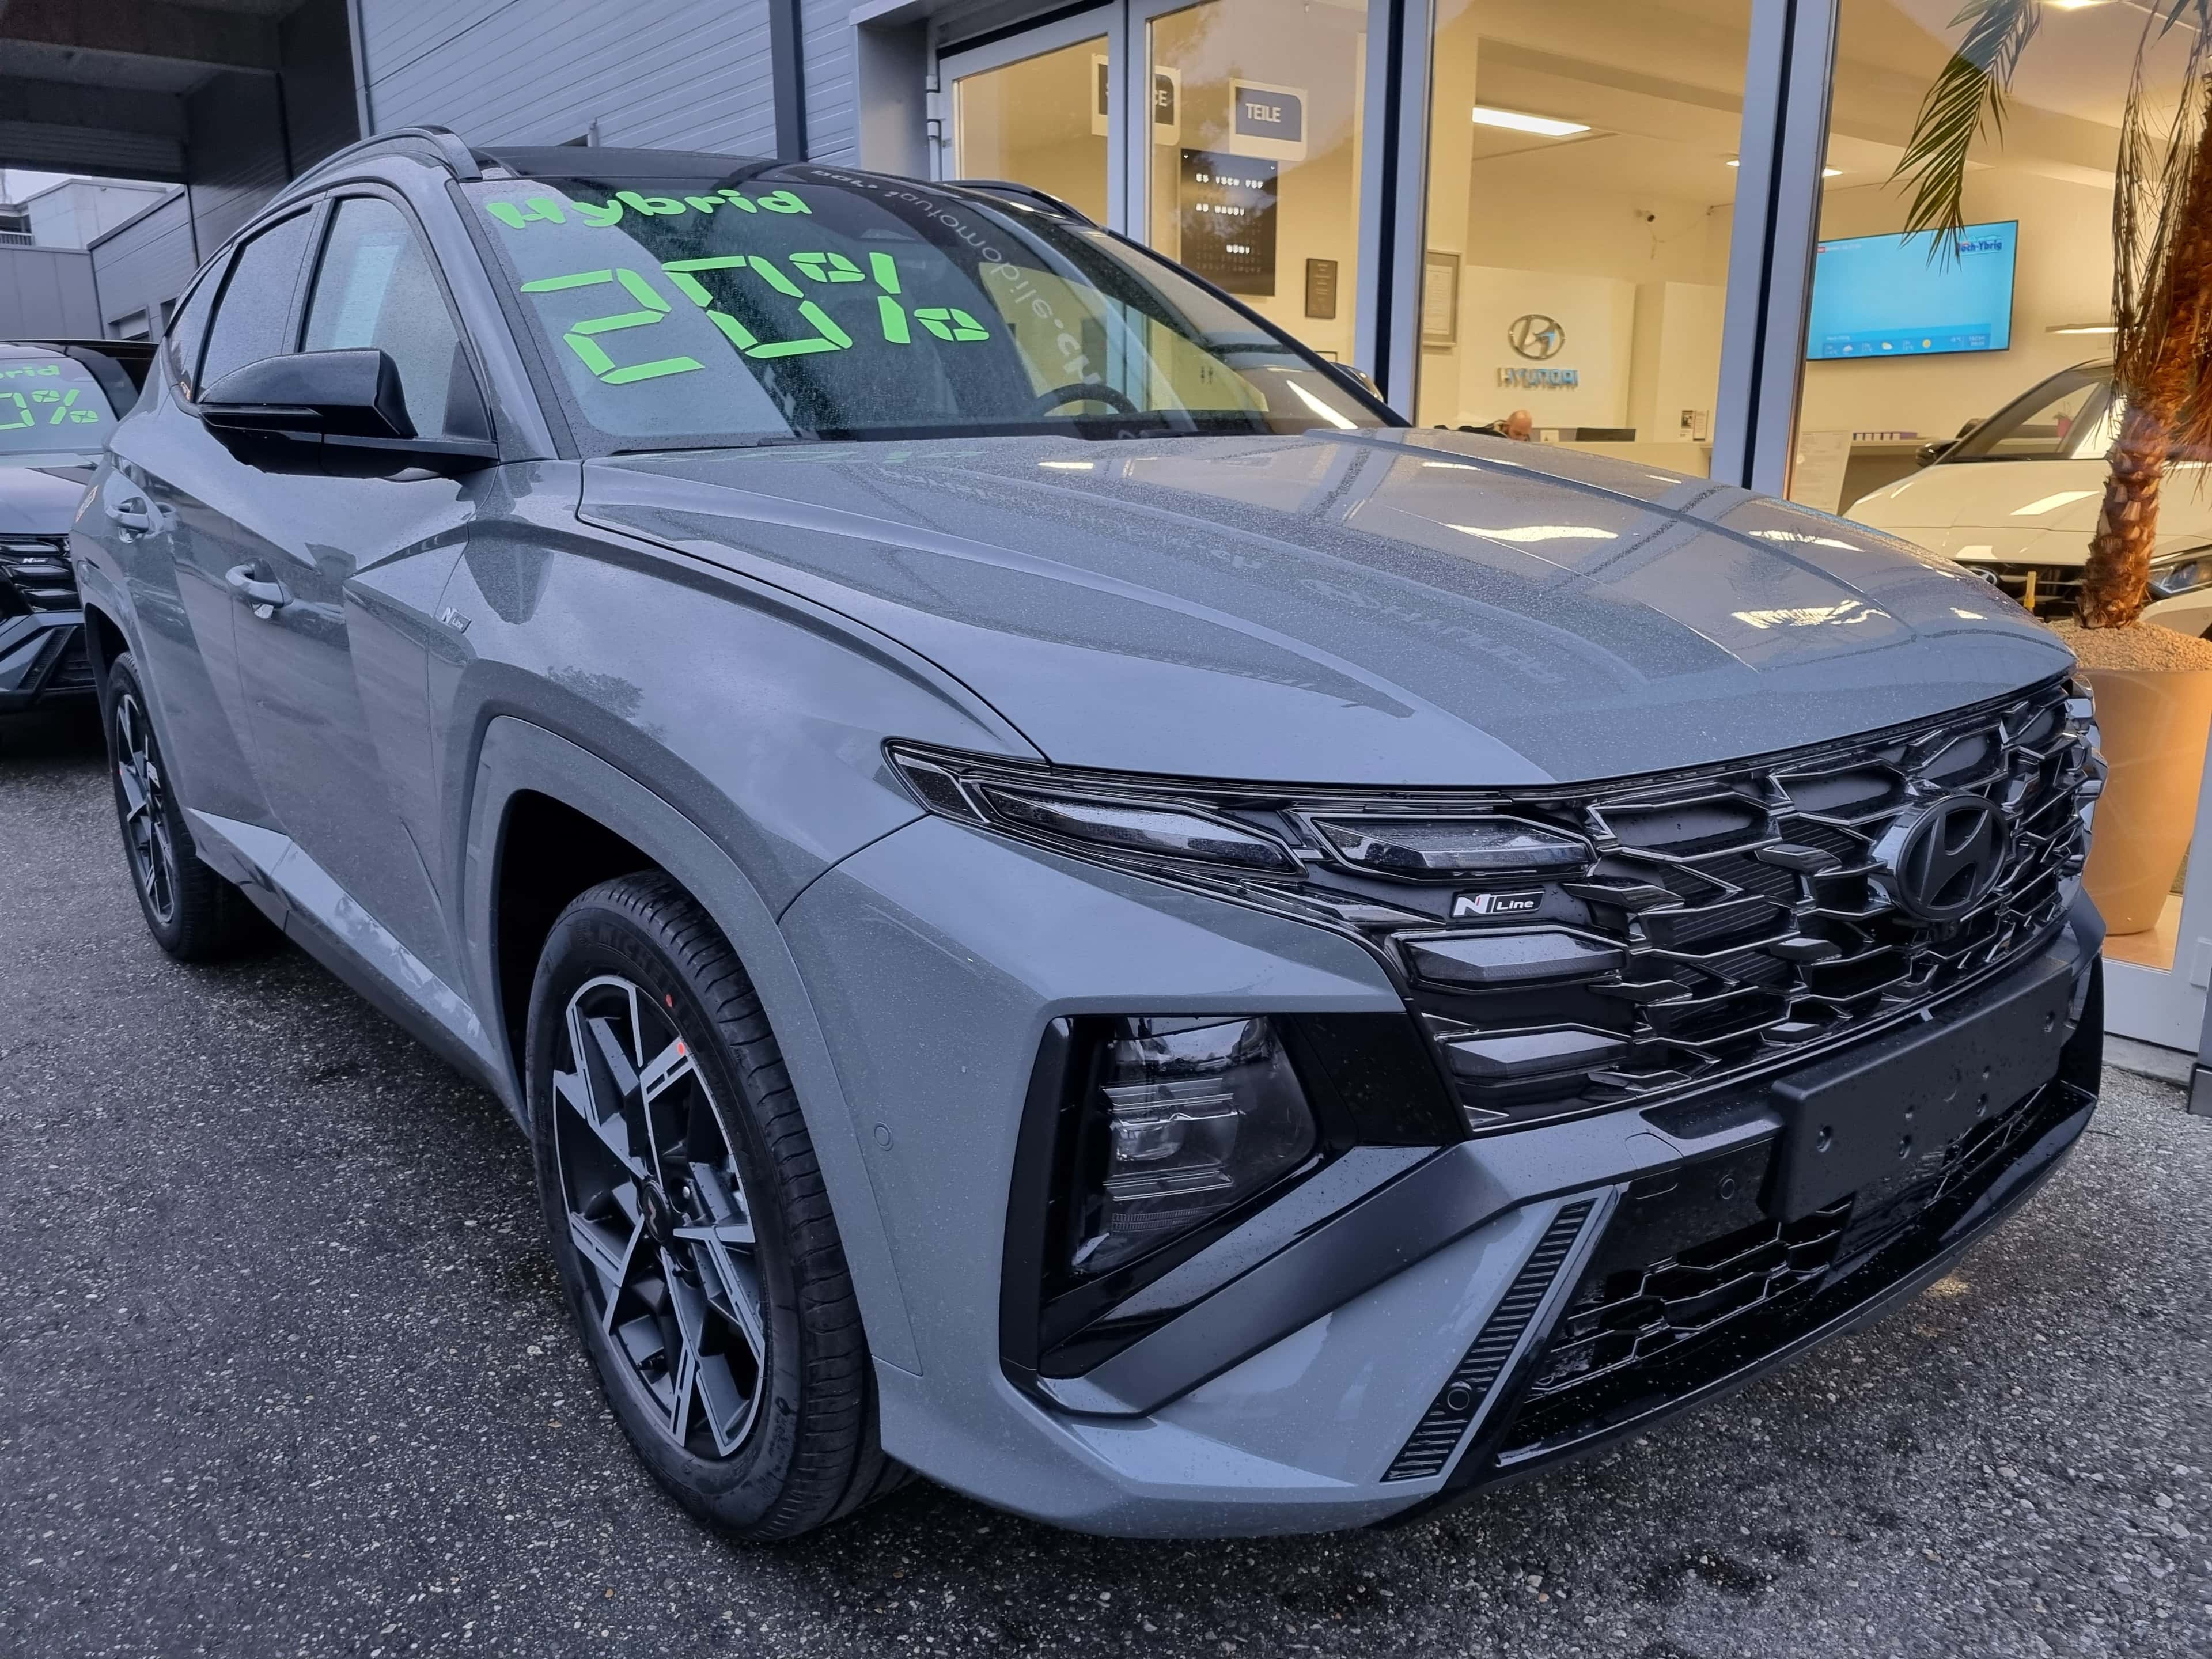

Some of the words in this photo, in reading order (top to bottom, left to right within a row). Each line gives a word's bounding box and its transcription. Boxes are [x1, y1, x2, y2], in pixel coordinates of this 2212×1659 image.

[1245, 103, 1281, 123] TEILE
[486, 189, 812, 228] Hybrid
[520, 251, 990, 384] 20%
[0, 365, 60, 379] rid
[1497, 368, 1579, 389] HYUNDAI
[1453, 893, 1491, 916] N
[1496, 900, 1534, 910] Line
